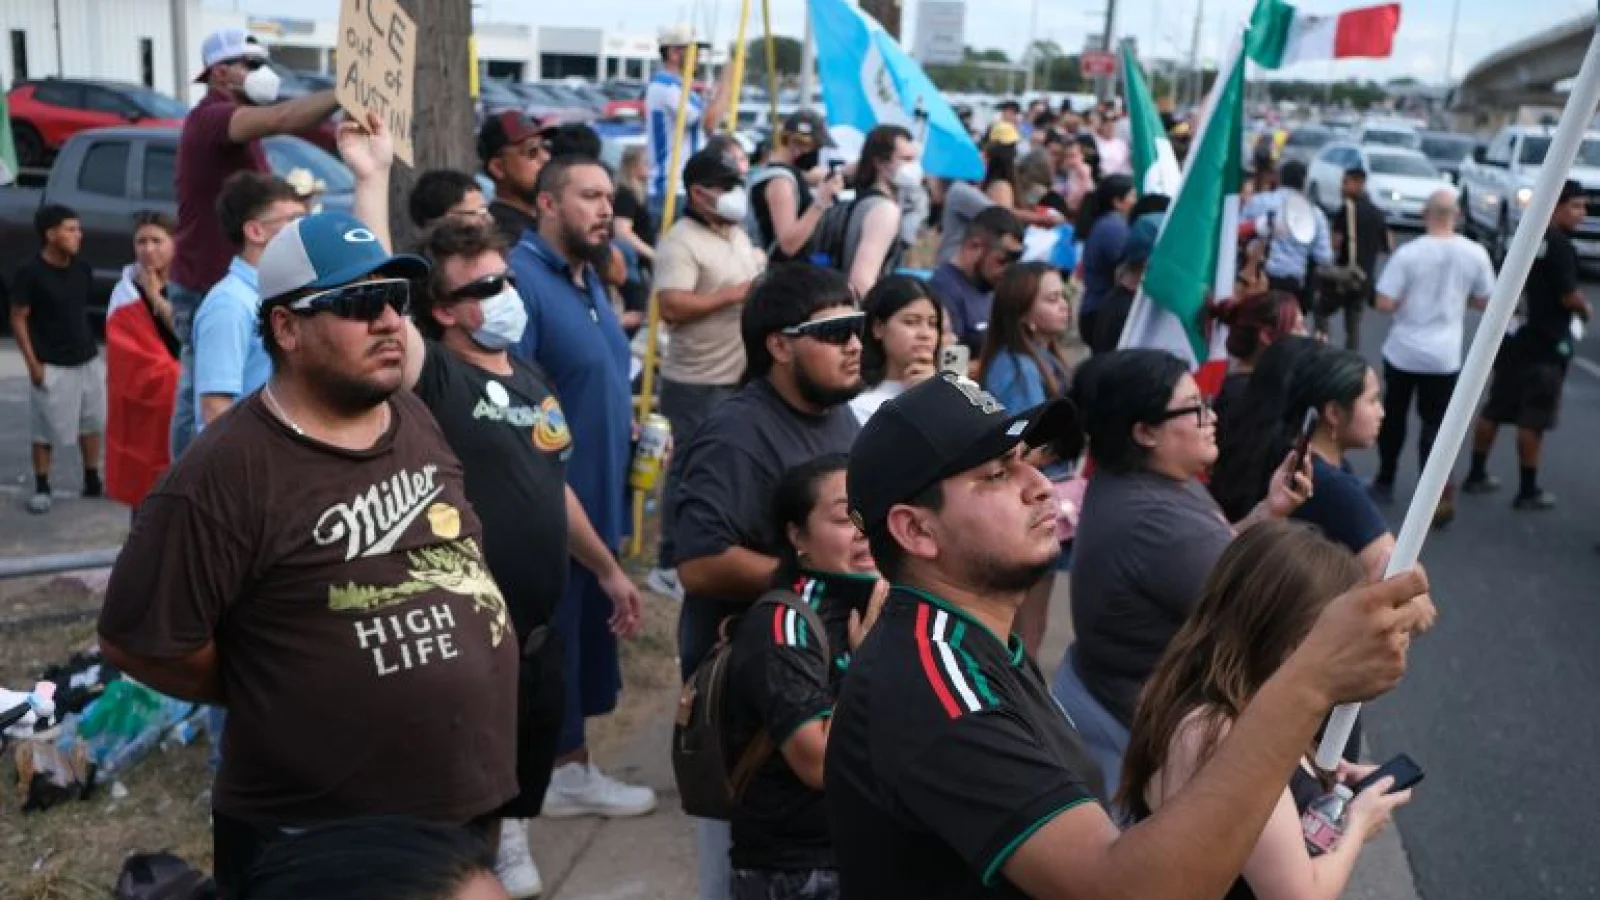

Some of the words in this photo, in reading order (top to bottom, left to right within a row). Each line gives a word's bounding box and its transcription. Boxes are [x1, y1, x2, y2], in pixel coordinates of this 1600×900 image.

[354, 0, 406, 65] CE
[384, 69, 402, 96] of
[312, 463, 440, 561] Miller
[354, 604, 456, 649] HIGH
[372, 633, 458, 676] LIFE
